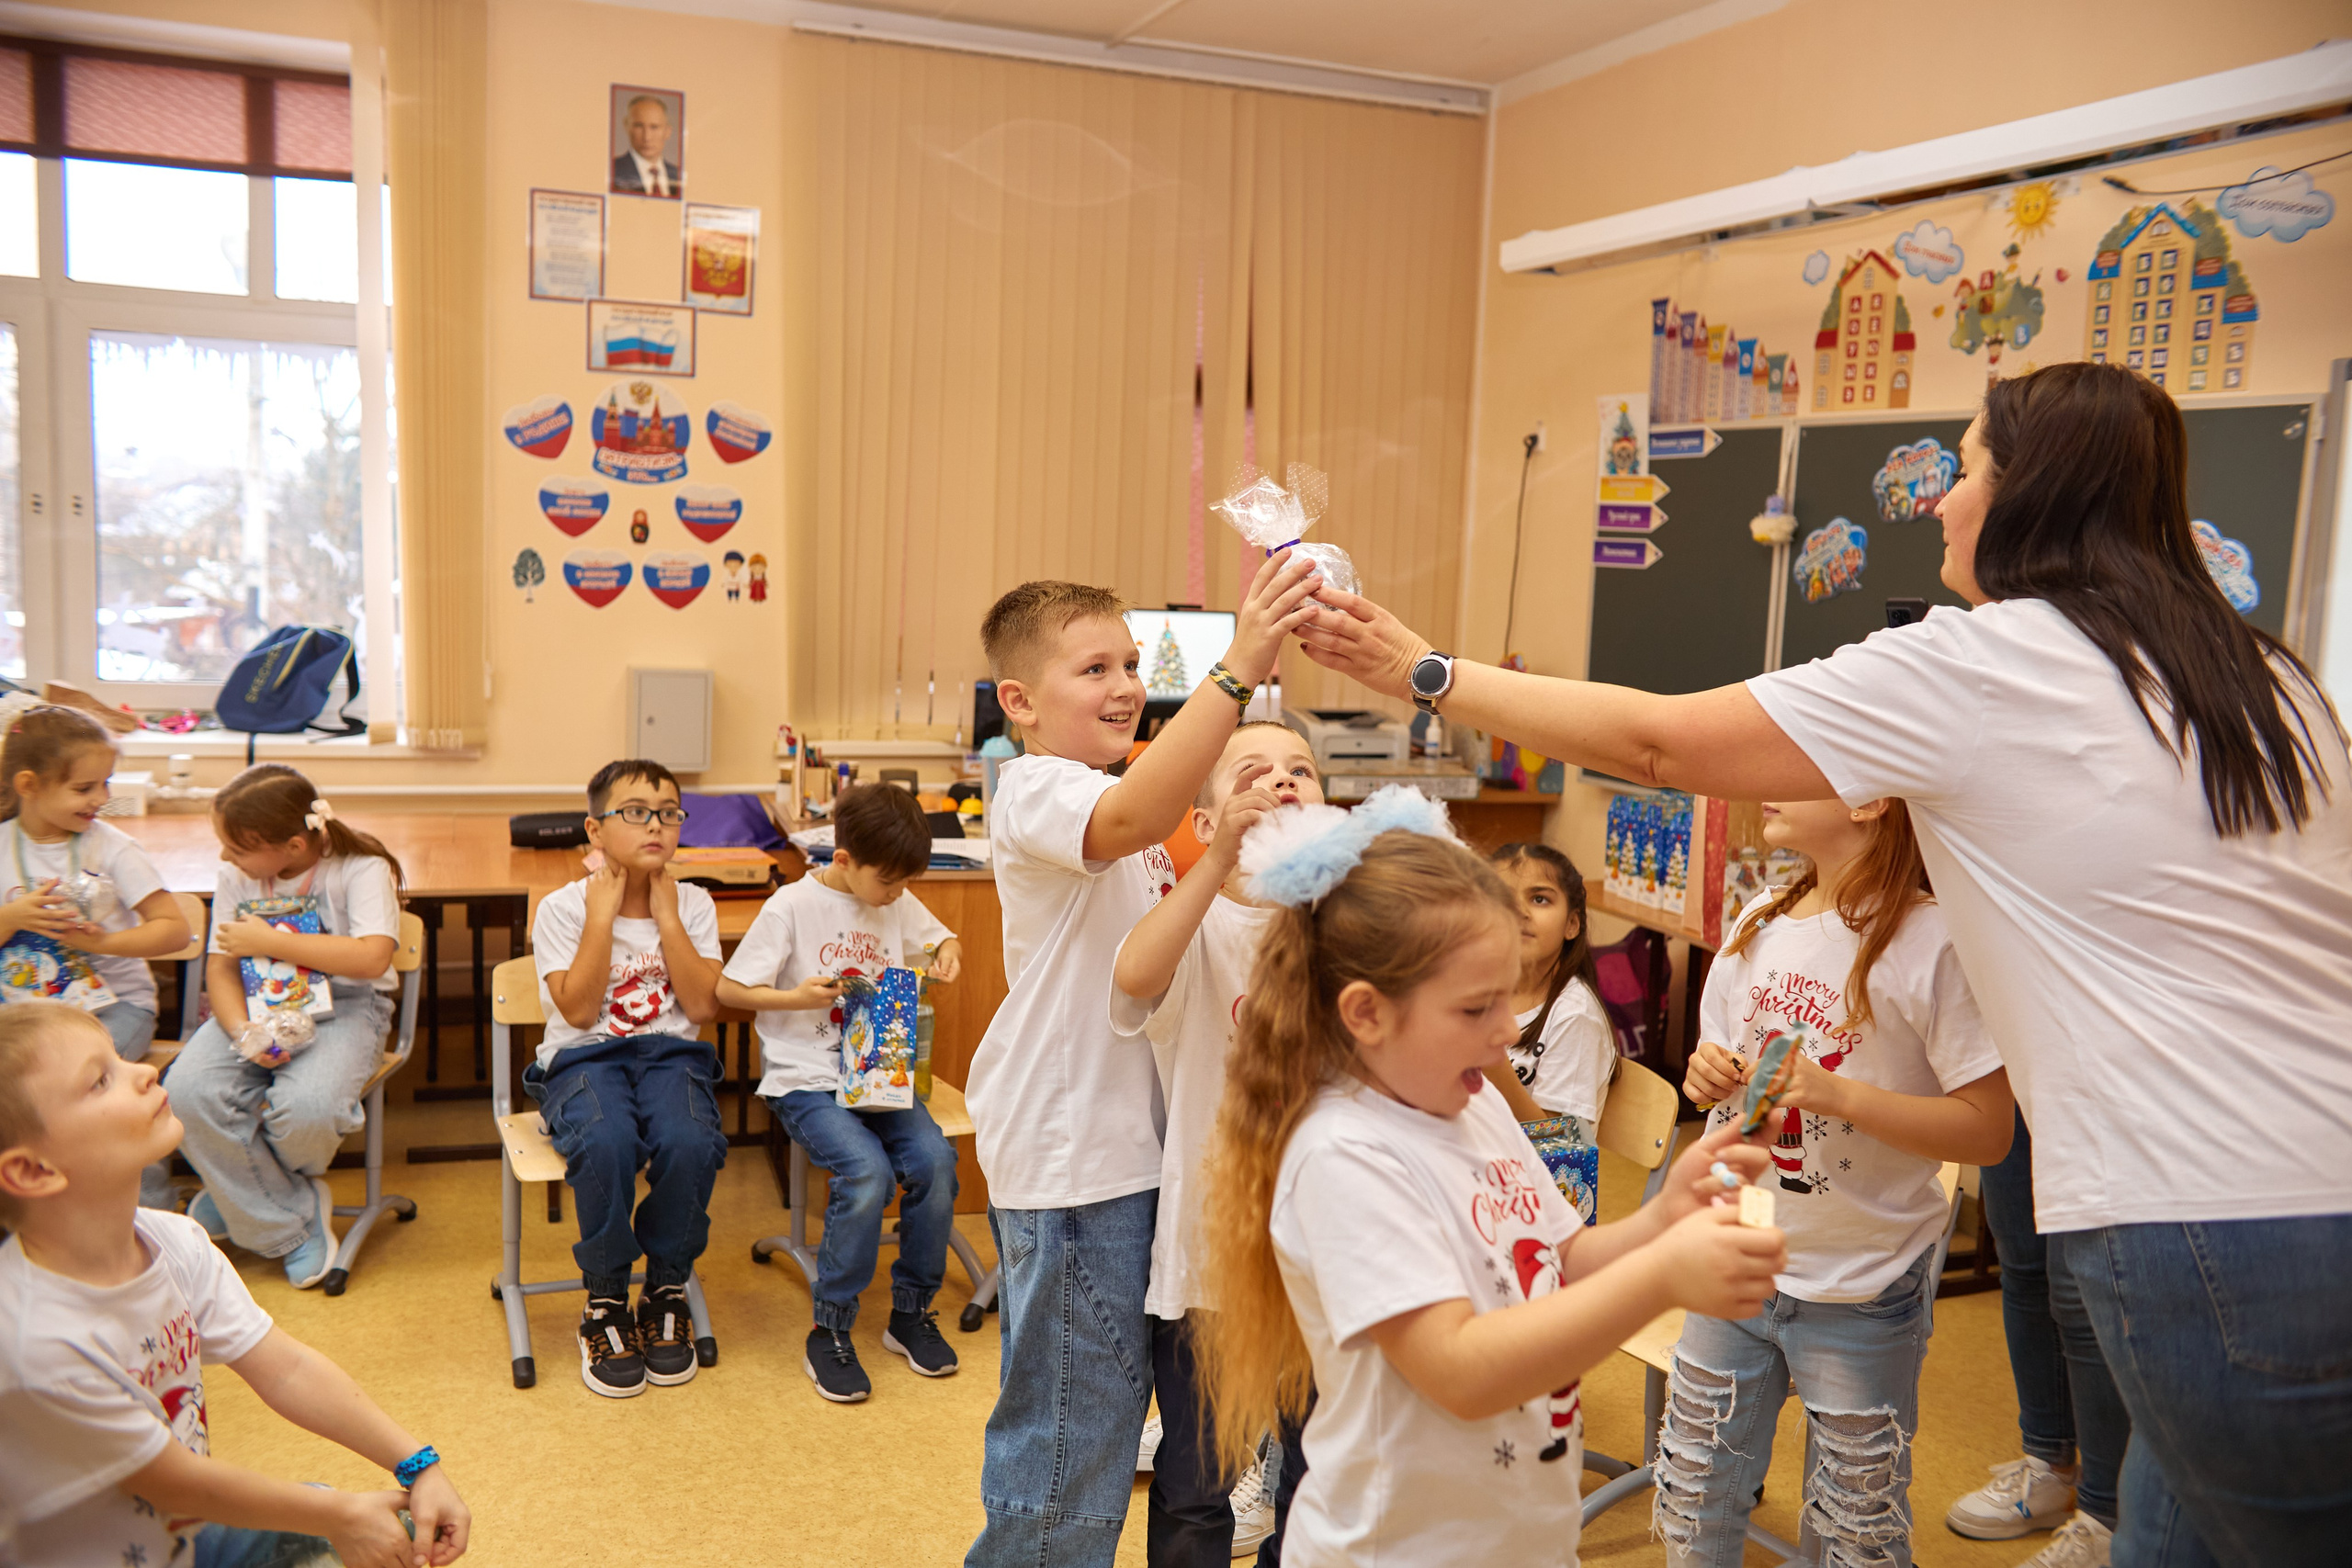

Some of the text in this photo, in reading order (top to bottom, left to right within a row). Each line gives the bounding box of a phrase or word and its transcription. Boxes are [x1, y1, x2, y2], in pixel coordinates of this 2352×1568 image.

[848, 931, 881, 949] Merry
[1780, 972, 1841, 1010] Merry
[1743, 986, 1863, 1055] Christmas
